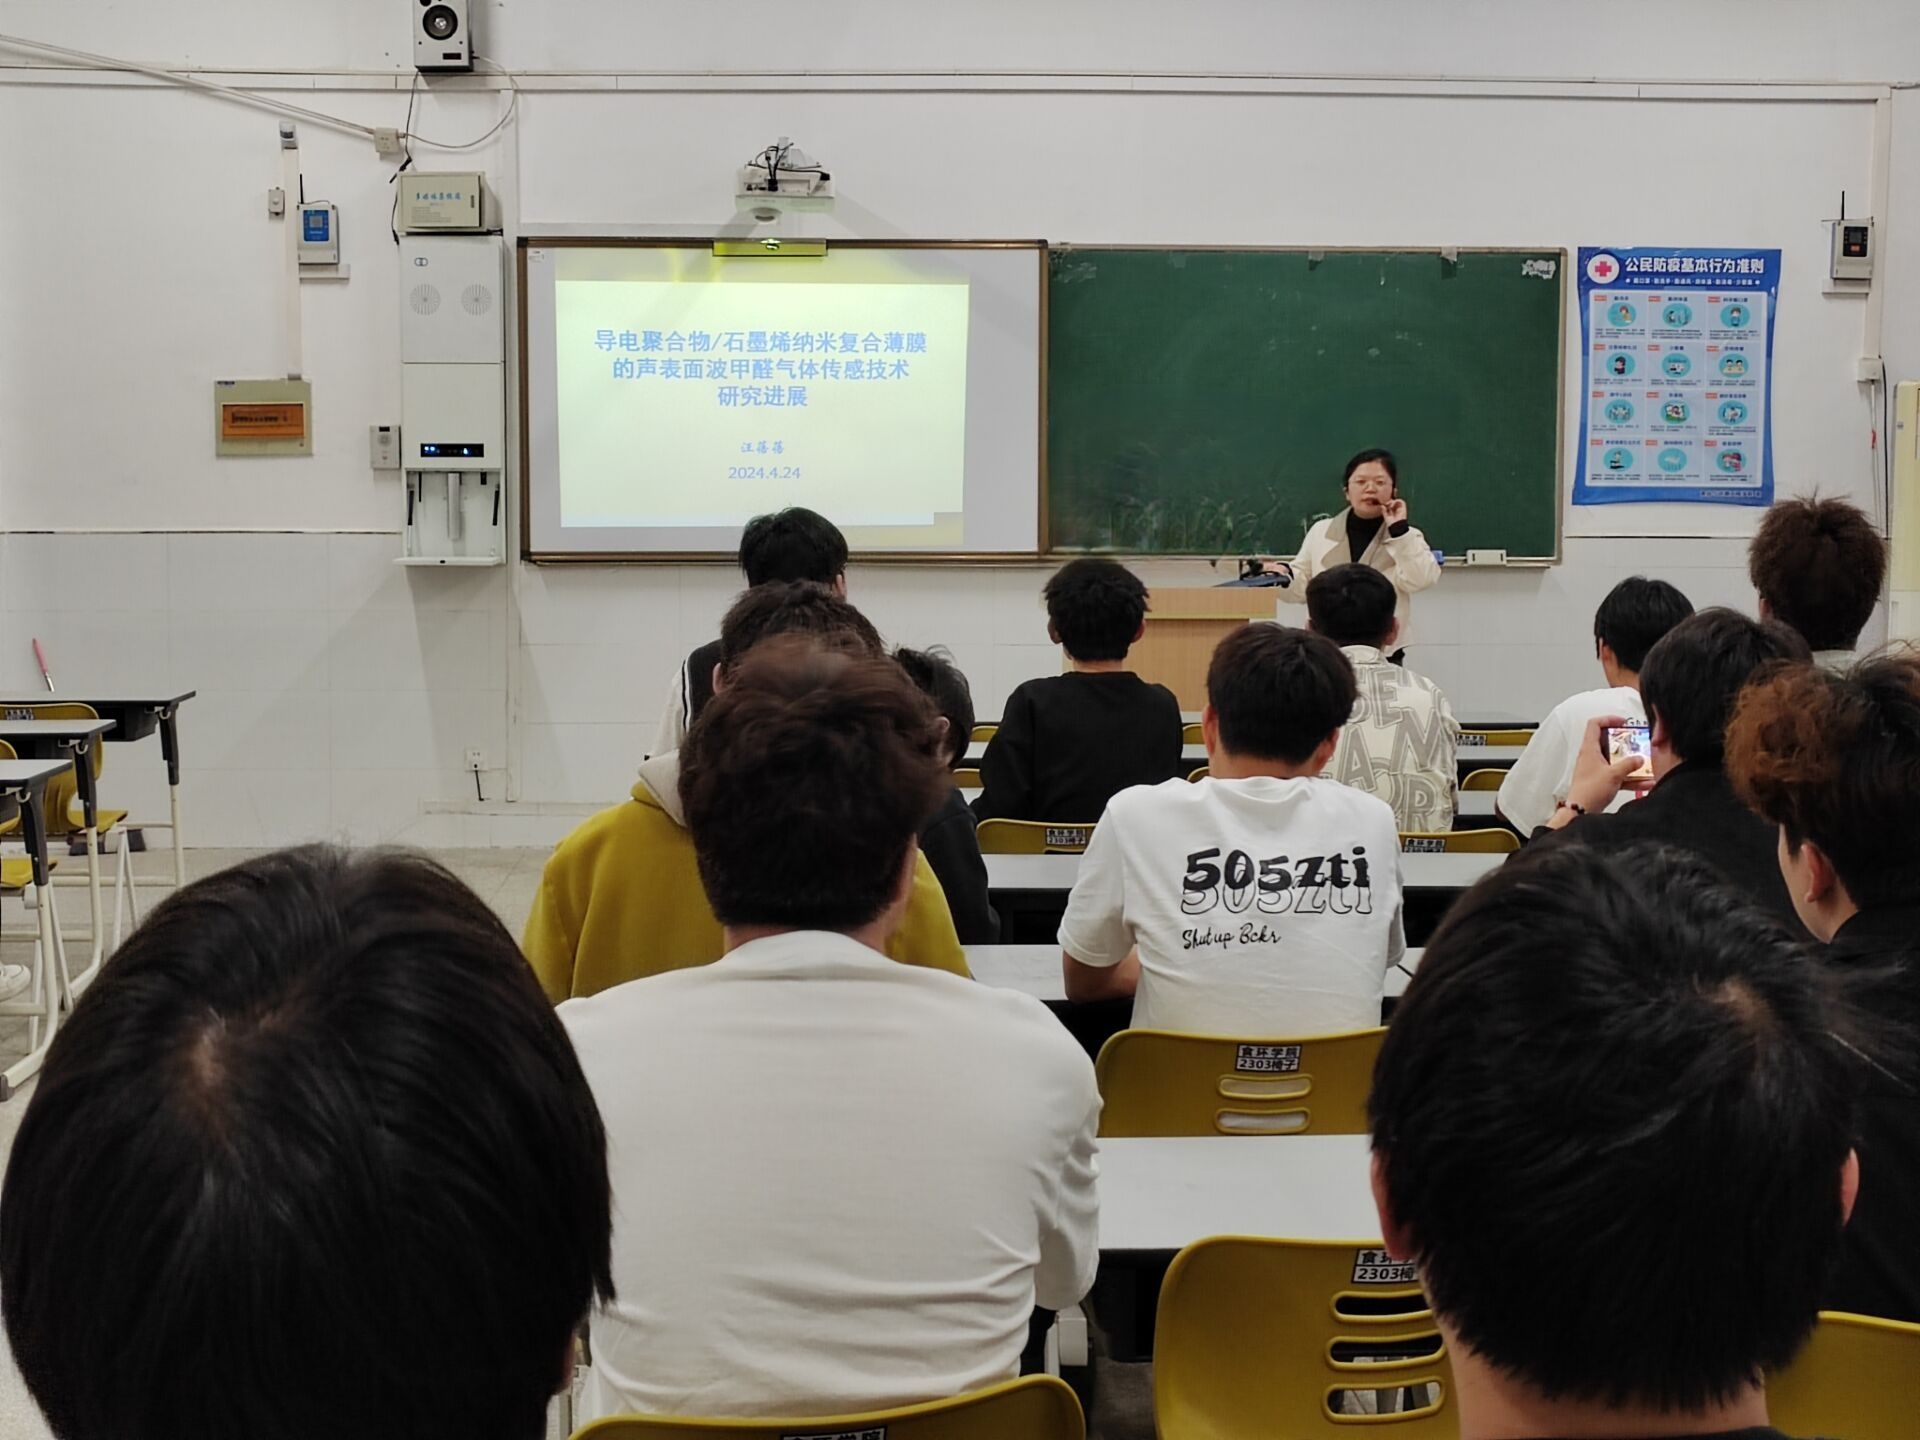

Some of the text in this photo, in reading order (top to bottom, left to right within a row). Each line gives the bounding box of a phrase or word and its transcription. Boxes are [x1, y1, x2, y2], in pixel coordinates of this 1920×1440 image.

[1625, 257, 1764, 274] 公民防疫基本行为准则
[594, 329, 927, 353] 导电聚合物/石墨烯纳米复合薄膜
[612, 357, 910, 380] 的声表面波甲醛气体传感技术
[717, 384, 809, 407] 研究进展
[728, 466, 801, 480] 2024.4.24
[1242, 1046, 1298, 1058] 食环学院
[1239, 1059, 1296, 1071] 2303椅子
[1358, 1267, 1414, 1281] 2303椅
